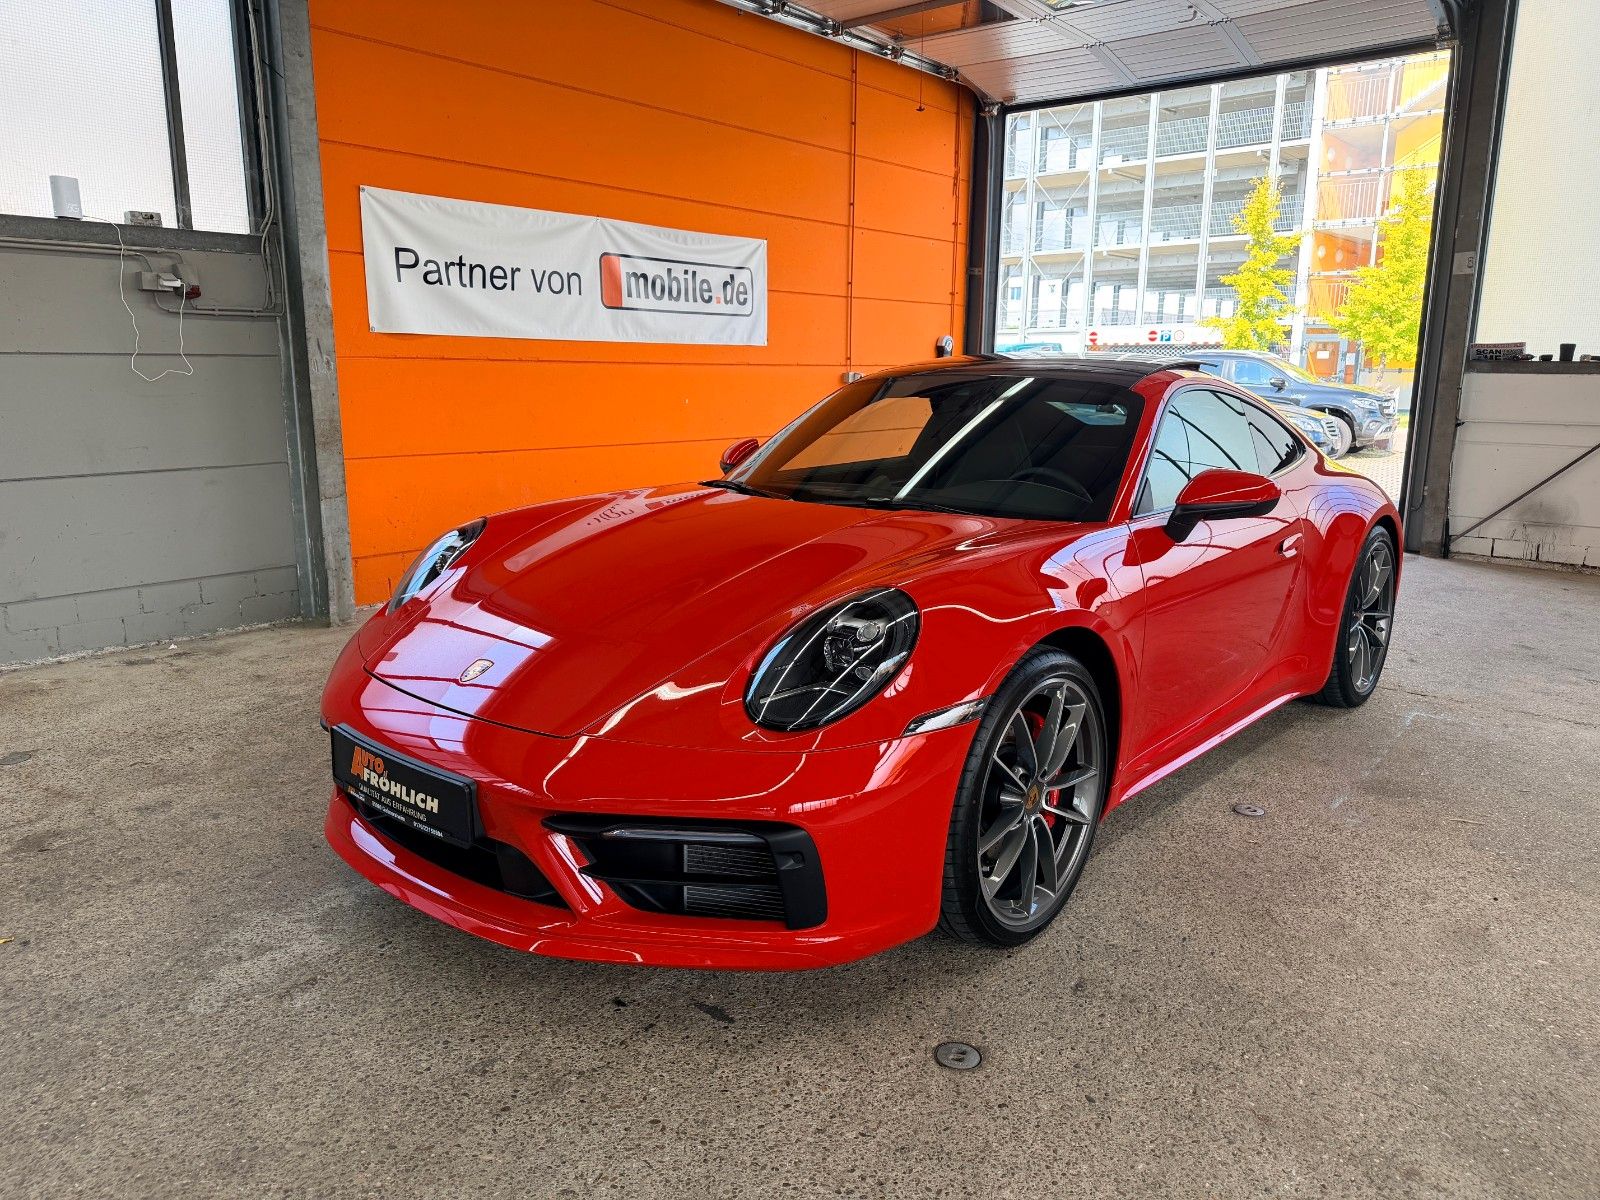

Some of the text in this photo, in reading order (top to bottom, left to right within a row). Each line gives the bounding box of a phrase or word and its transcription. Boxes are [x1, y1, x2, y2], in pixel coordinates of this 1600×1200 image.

[394, 246, 749, 307] Partner von mobile.de
[351, 746, 384, 778] AUTO
[363, 769, 439, 813] FRÖHLICH
